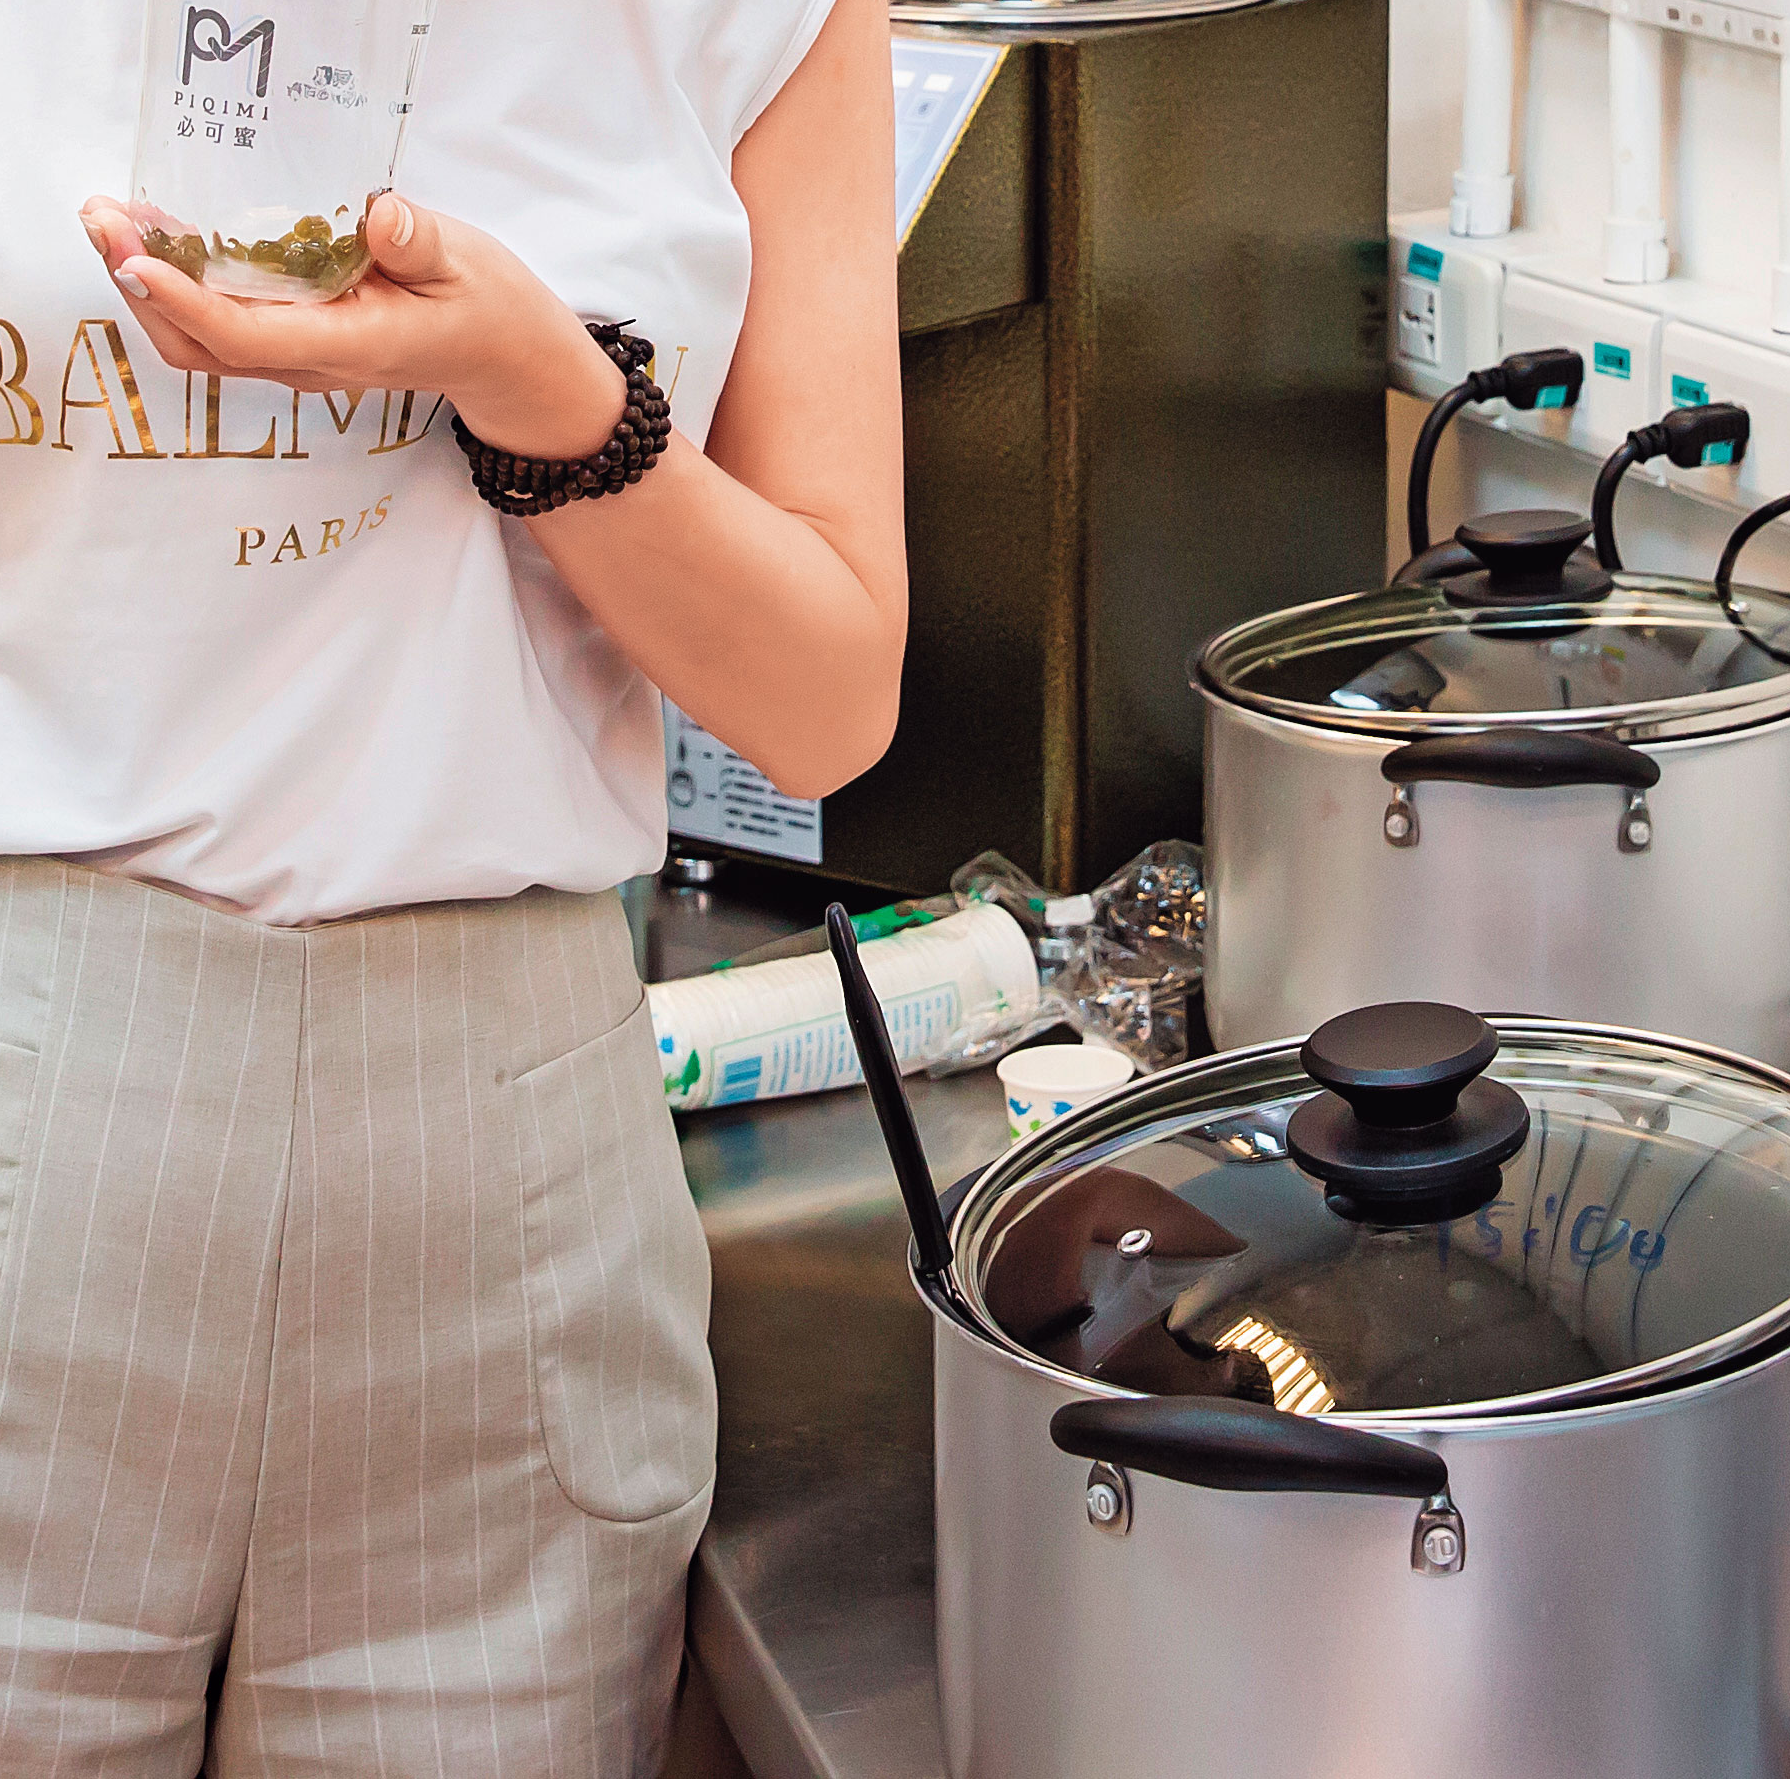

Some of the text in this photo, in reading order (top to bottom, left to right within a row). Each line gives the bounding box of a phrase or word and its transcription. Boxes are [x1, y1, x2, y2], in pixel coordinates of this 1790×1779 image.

[177, 115, 256, 149] 必可蜜
[234, 493, 392, 566] PARIS
